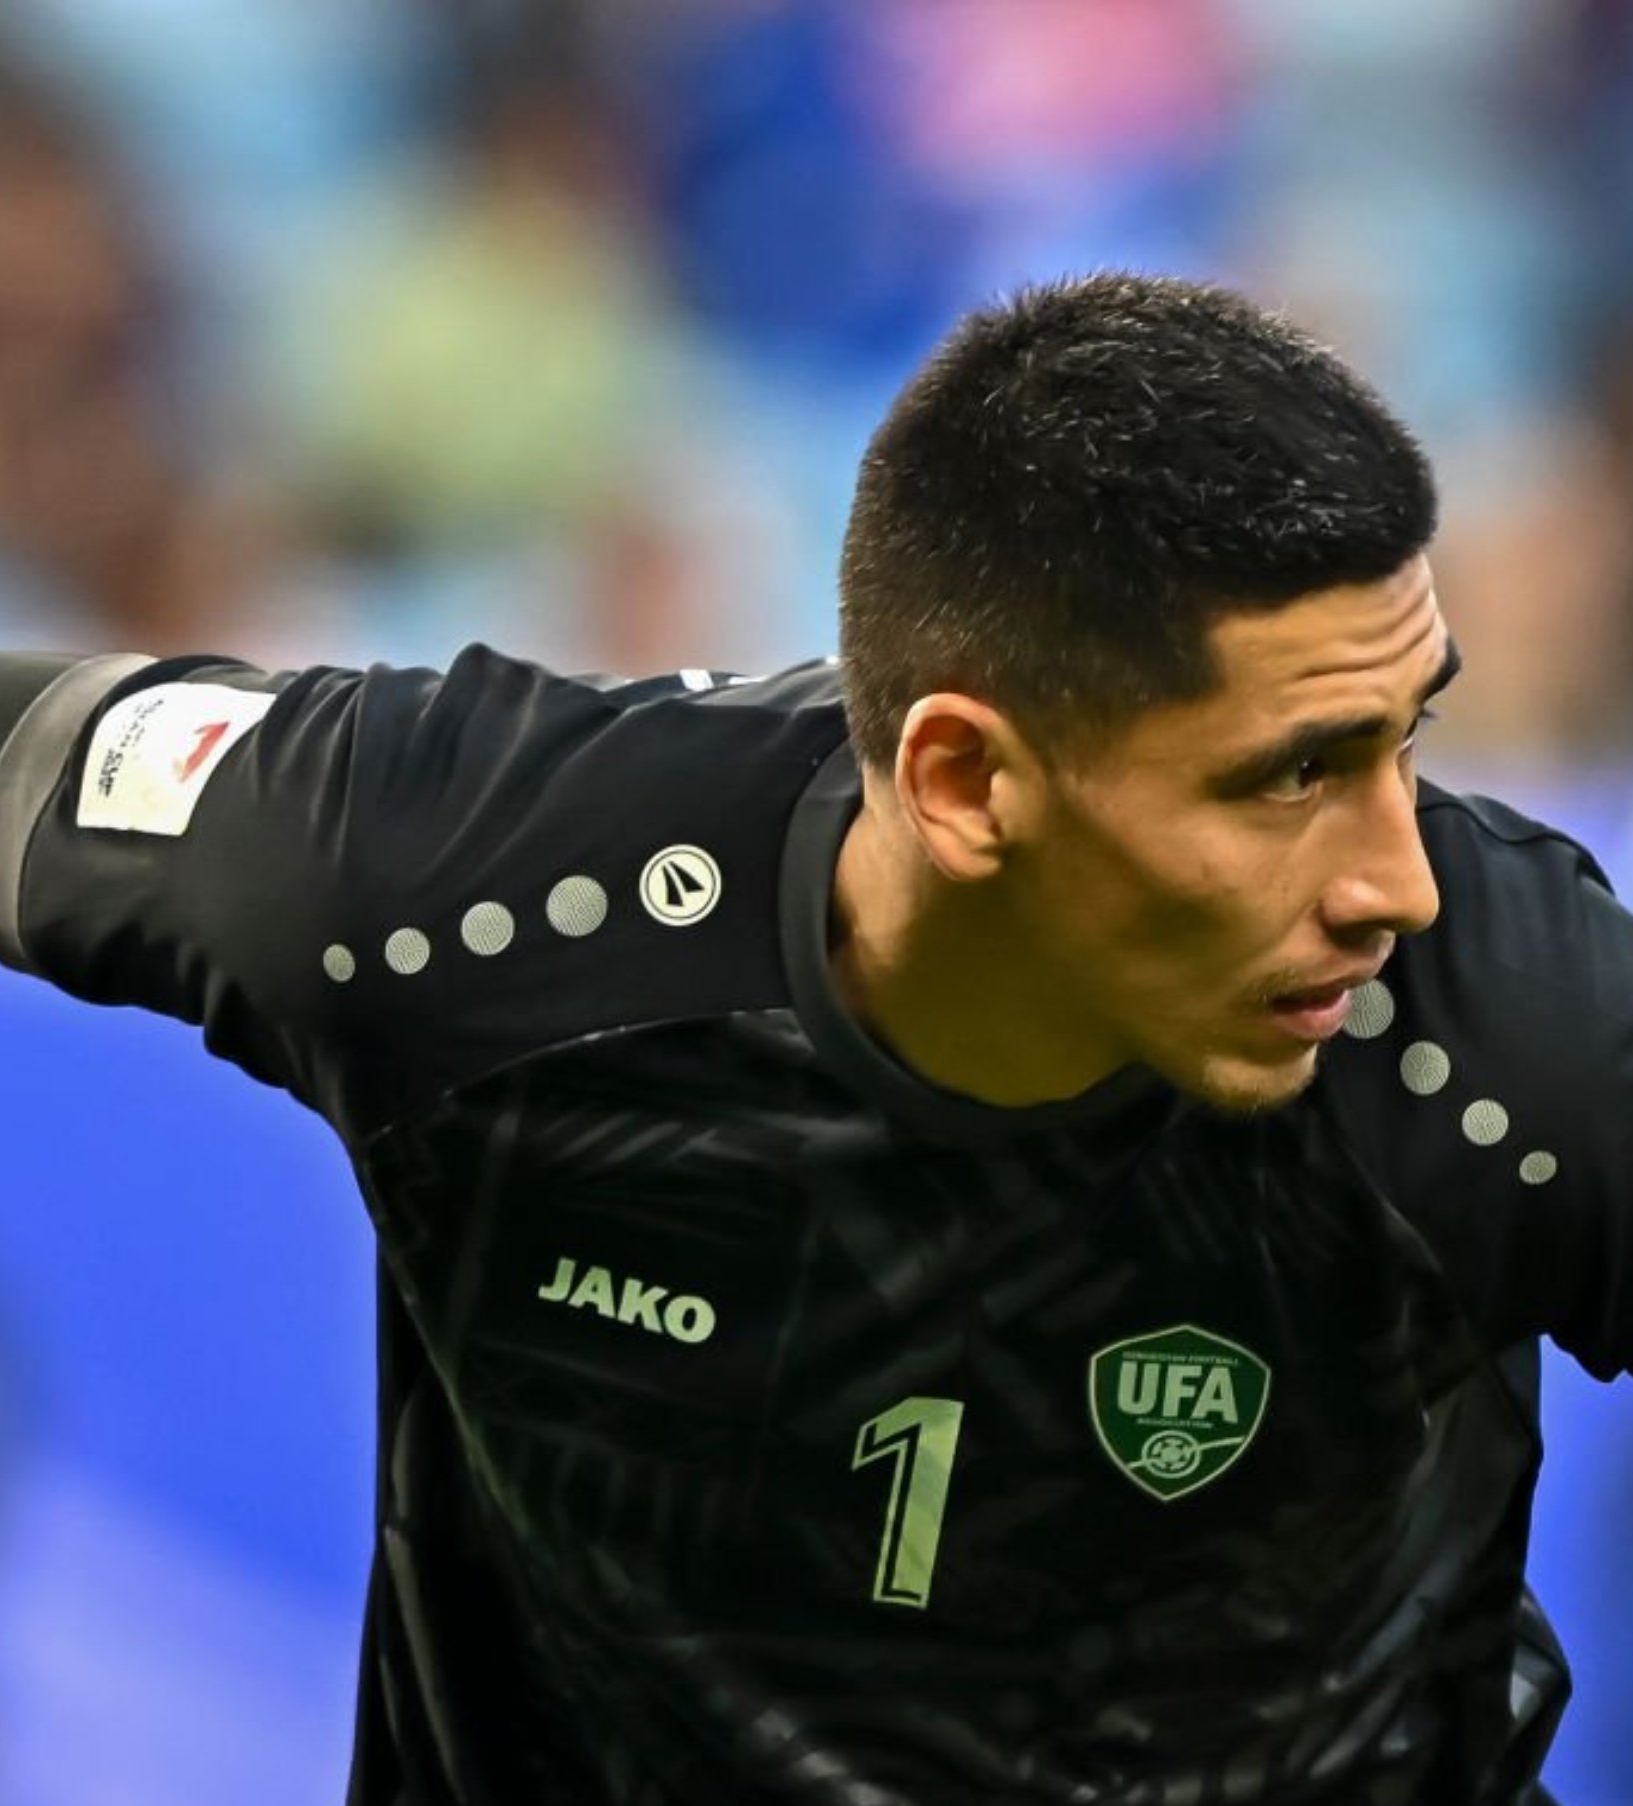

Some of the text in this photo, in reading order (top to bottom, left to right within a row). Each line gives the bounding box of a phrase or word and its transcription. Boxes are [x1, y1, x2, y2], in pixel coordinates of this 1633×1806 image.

[538, 1257, 716, 1343] JAKO
[1117, 1361, 1238, 1424] UFA
[851, 1396, 965, 1610] 1
